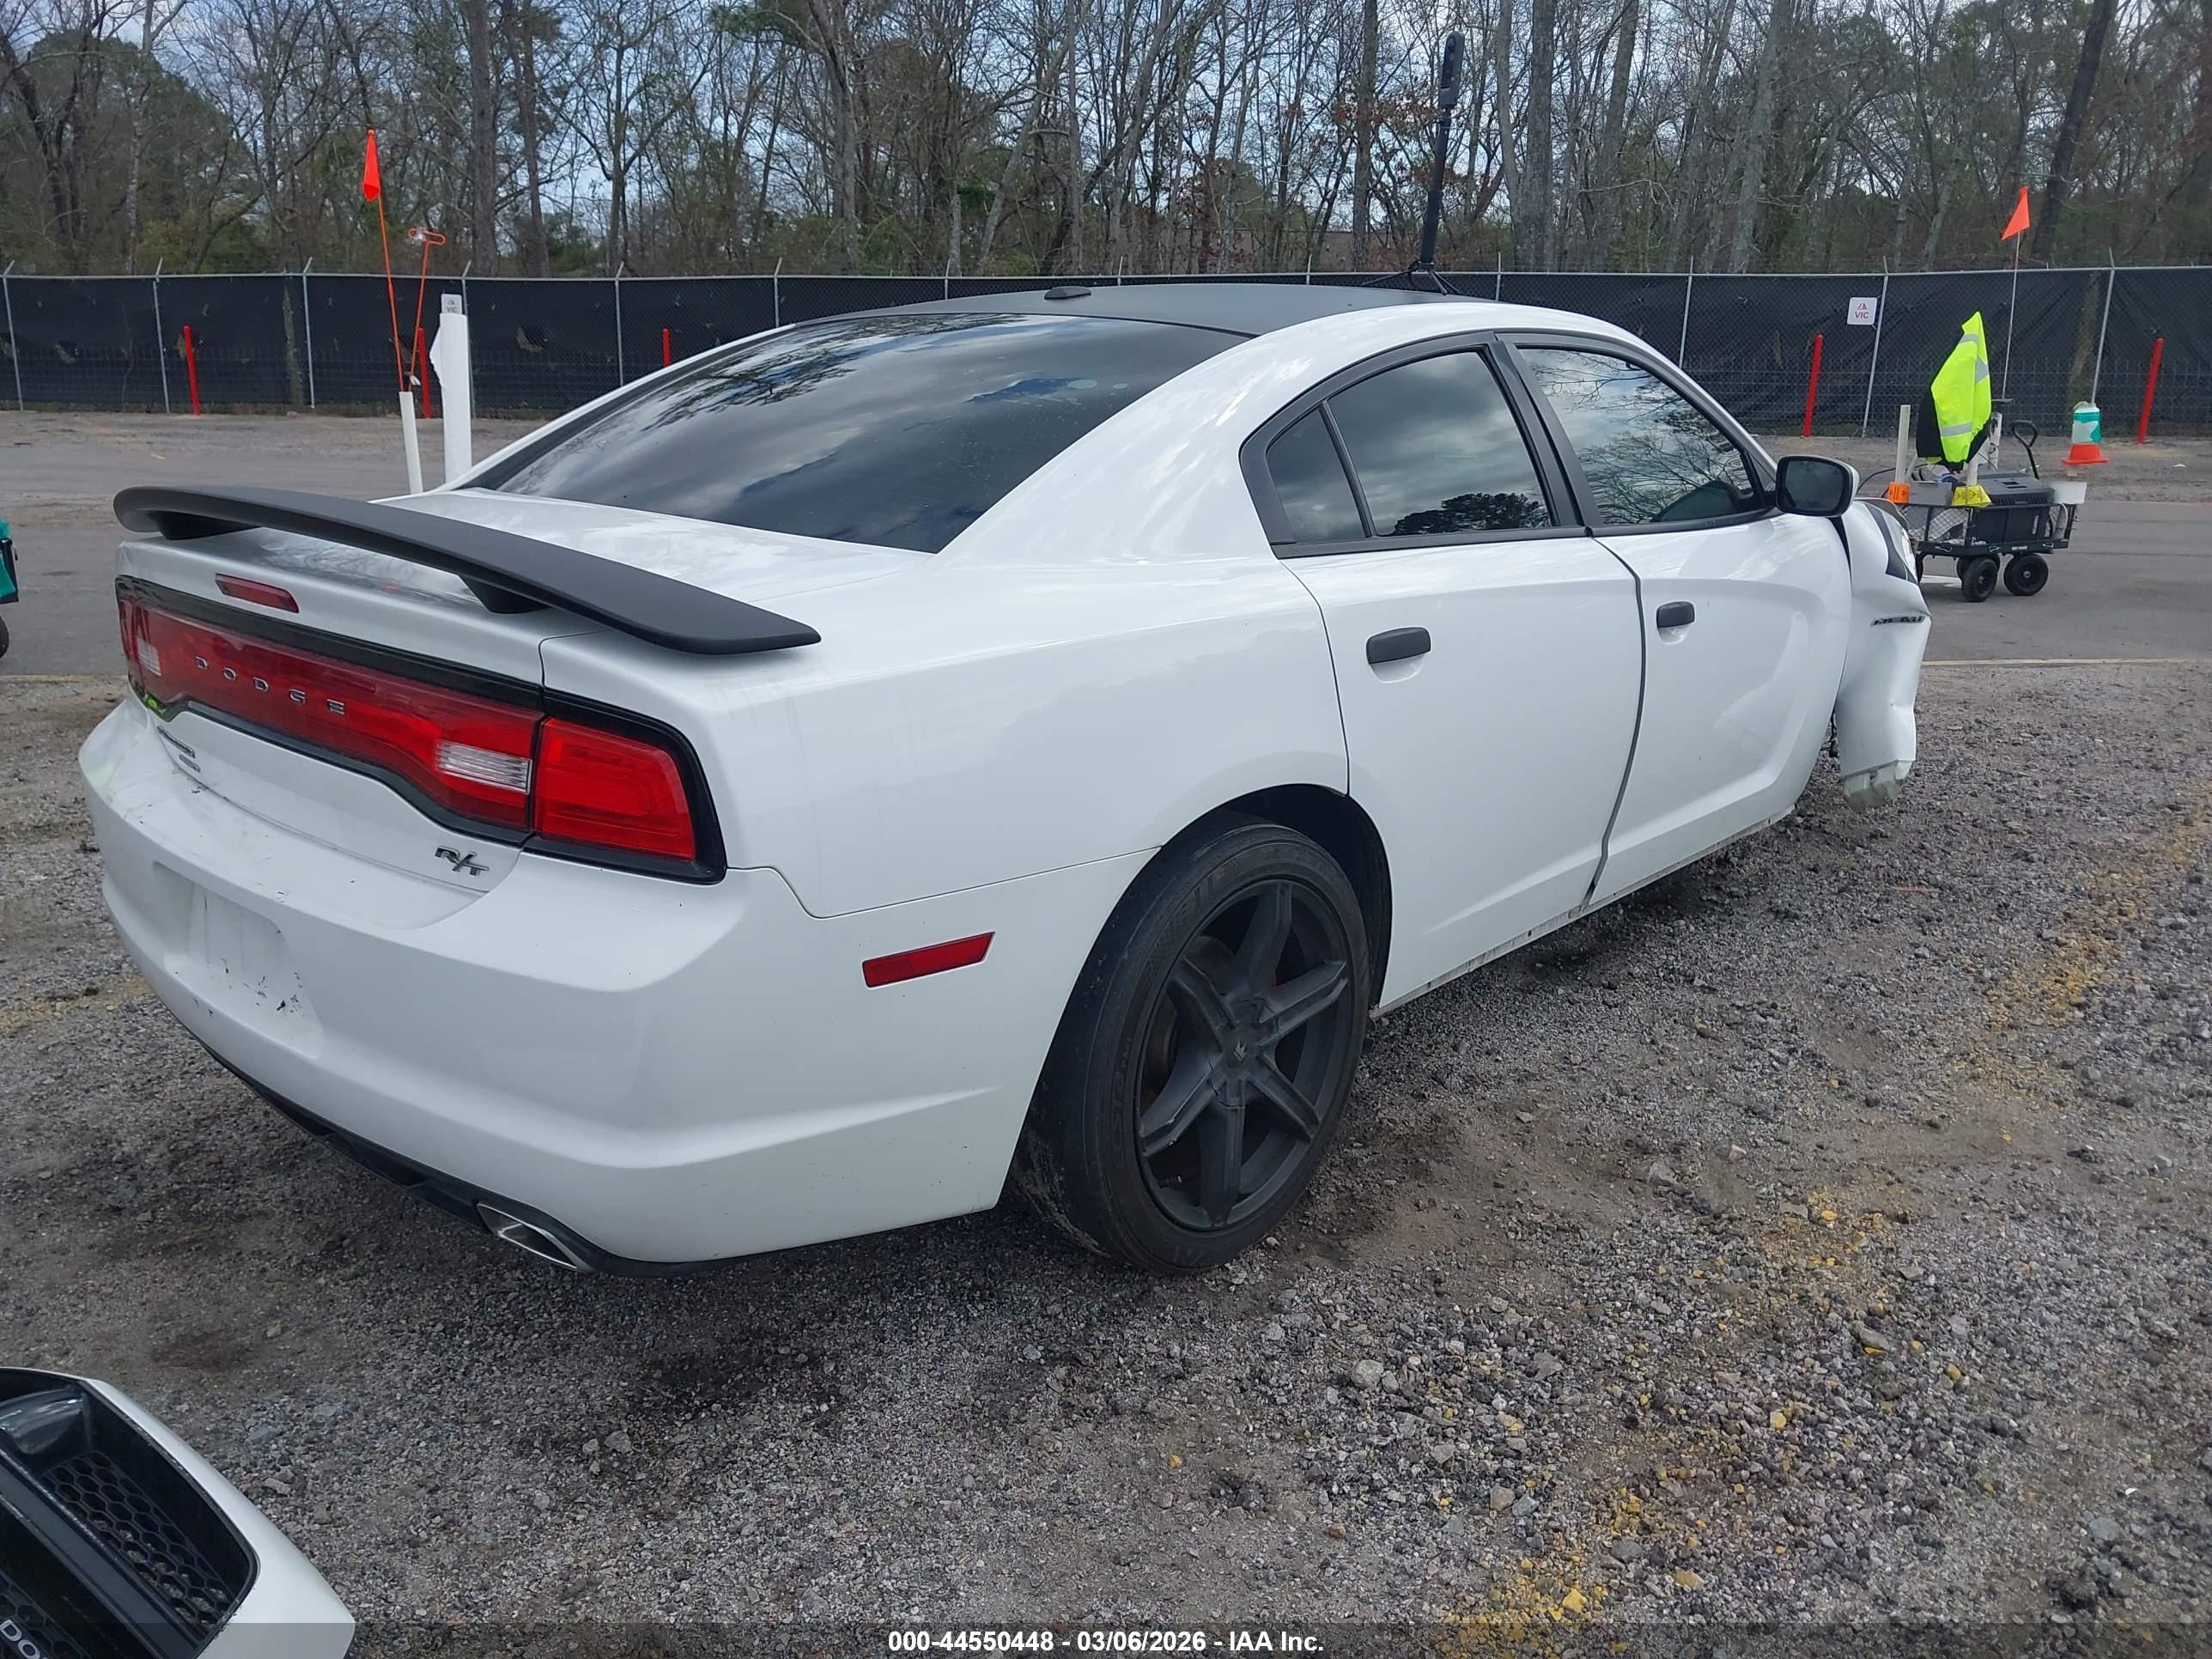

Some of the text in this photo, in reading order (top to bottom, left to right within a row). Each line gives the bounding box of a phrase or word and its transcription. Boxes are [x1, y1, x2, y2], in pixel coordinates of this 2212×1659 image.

[1855, 311, 1869, 319] VIC
[194, 656, 346, 715] DODGE
[434, 846, 489, 877] R/T
[0, 1619, 48, 1659] DO
